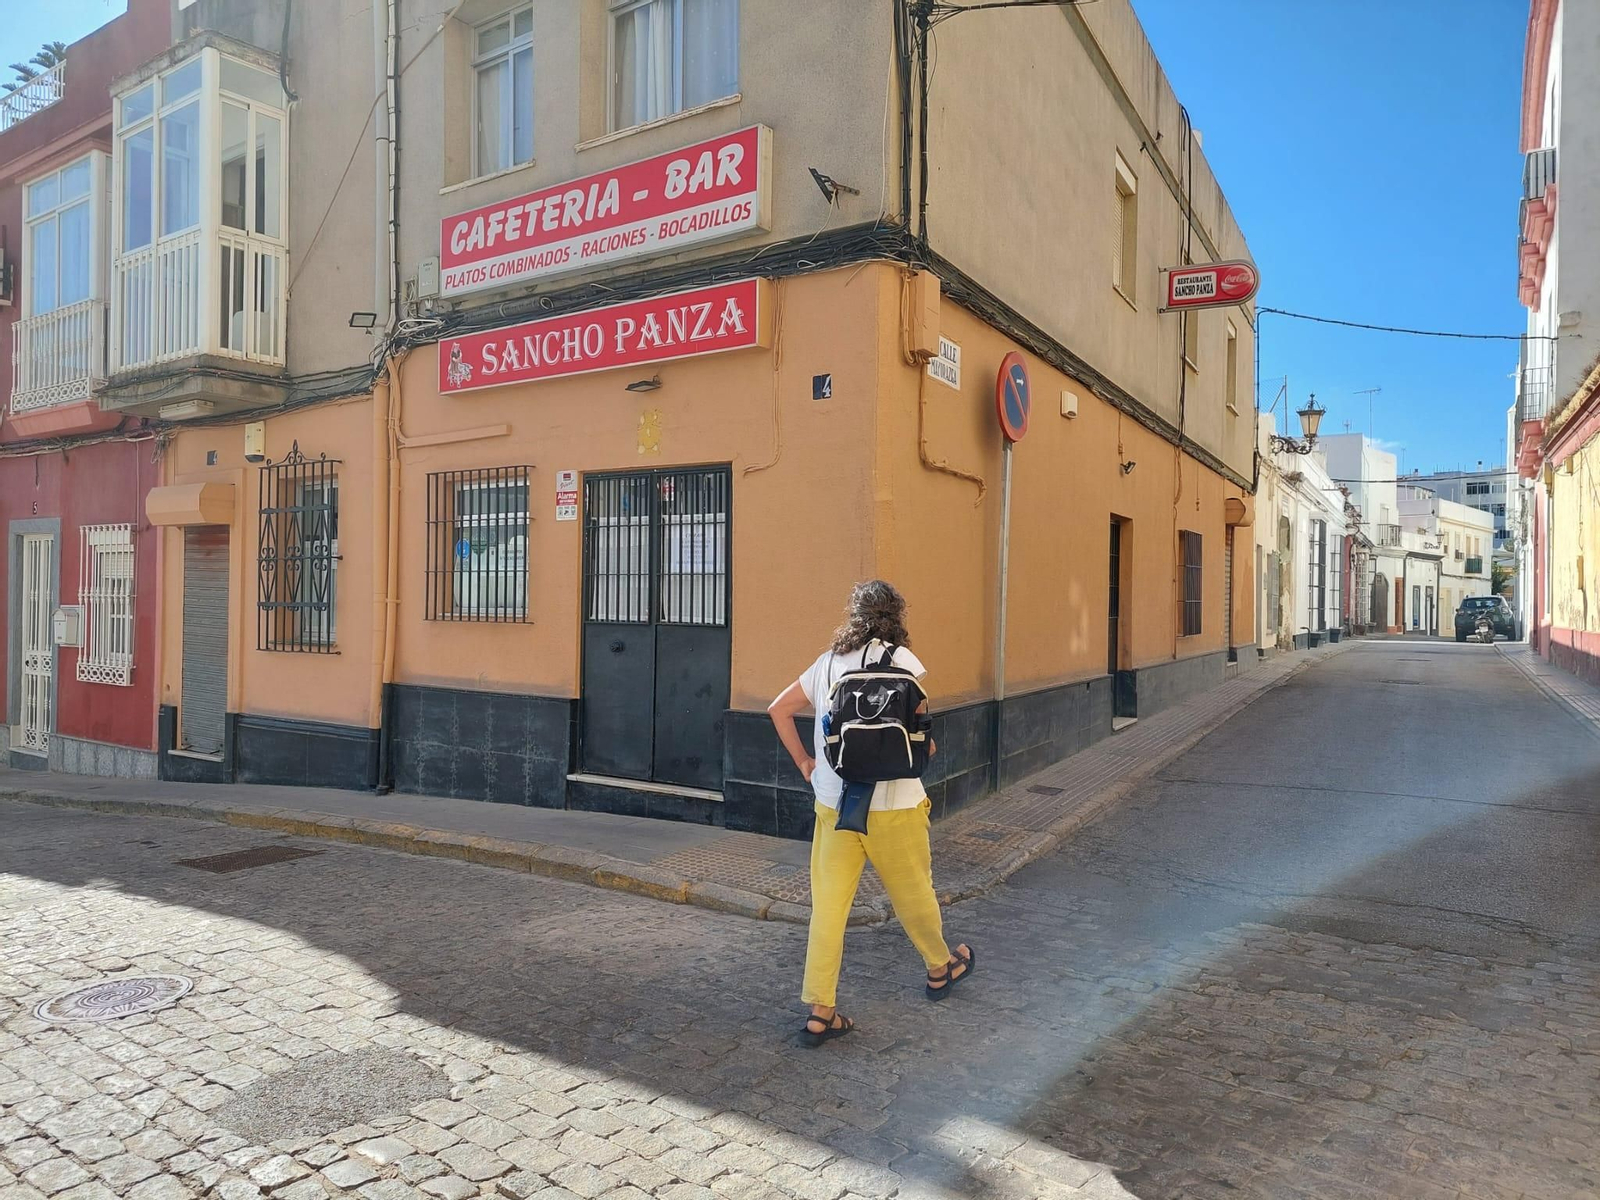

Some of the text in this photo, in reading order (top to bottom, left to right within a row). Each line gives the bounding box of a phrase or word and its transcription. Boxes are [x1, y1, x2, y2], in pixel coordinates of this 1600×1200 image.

[451, 143, 745, 255] CAFETERIA - BAR
[445, 266, 487, 290] PLATOS
[489, 246, 571, 280] COMBINADOS
[581, 227, 647, 258] RACIONES
[658, 201, 752, 240] BOCADILLOS
[1175, 283, 1214, 297] SANCHO PANZA
[1177, 275, 1212, 285] RESTAURANTE
[481, 297, 748, 376] SANCHO PANZA
[940, 340, 957, 364] CALLE
[822, 374, 831, 398] 4
[557, 491, 577, 500] Alarma
